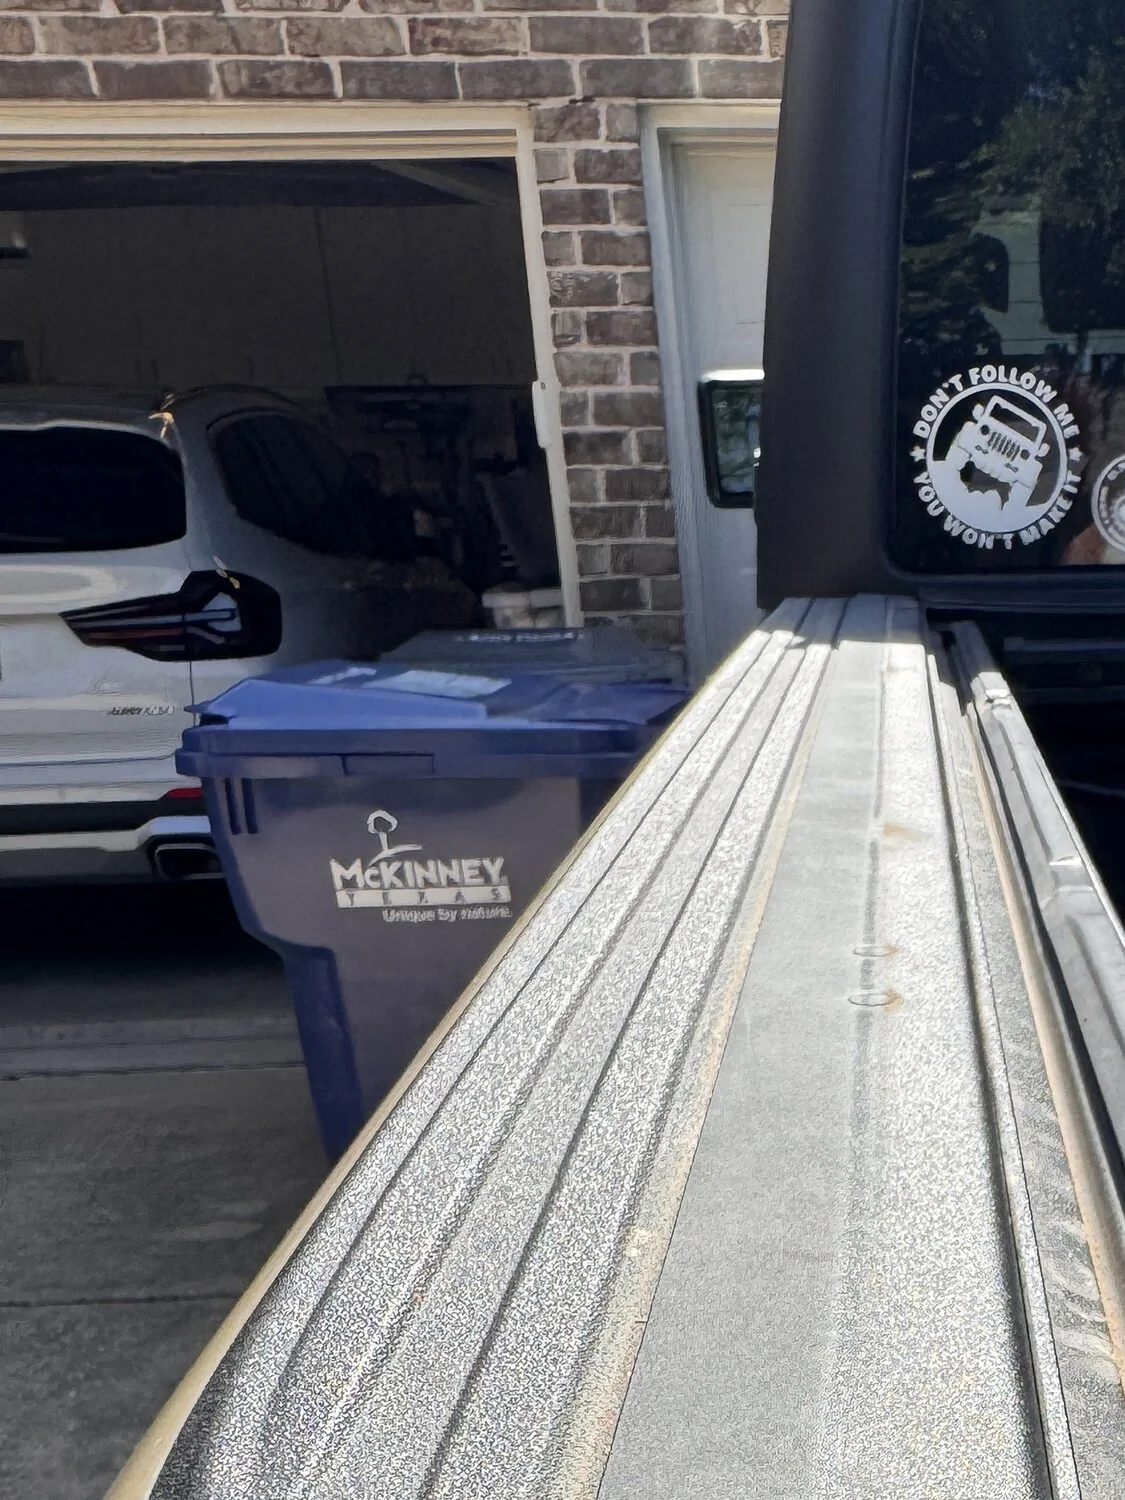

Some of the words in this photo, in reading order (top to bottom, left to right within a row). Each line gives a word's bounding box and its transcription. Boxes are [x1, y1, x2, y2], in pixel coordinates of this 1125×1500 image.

[912, 373, 964, 439] DON'T
[968, 364, 1058, 402] FOLLOW
[1053, 403, 1081, 439] ME
[913, 471, 945, 517] YOU
[943, 514, 1015, 550] WON'T
[1019, 495, 1074, 546] MAKE
[1063, 470, 1082, 494] IT
